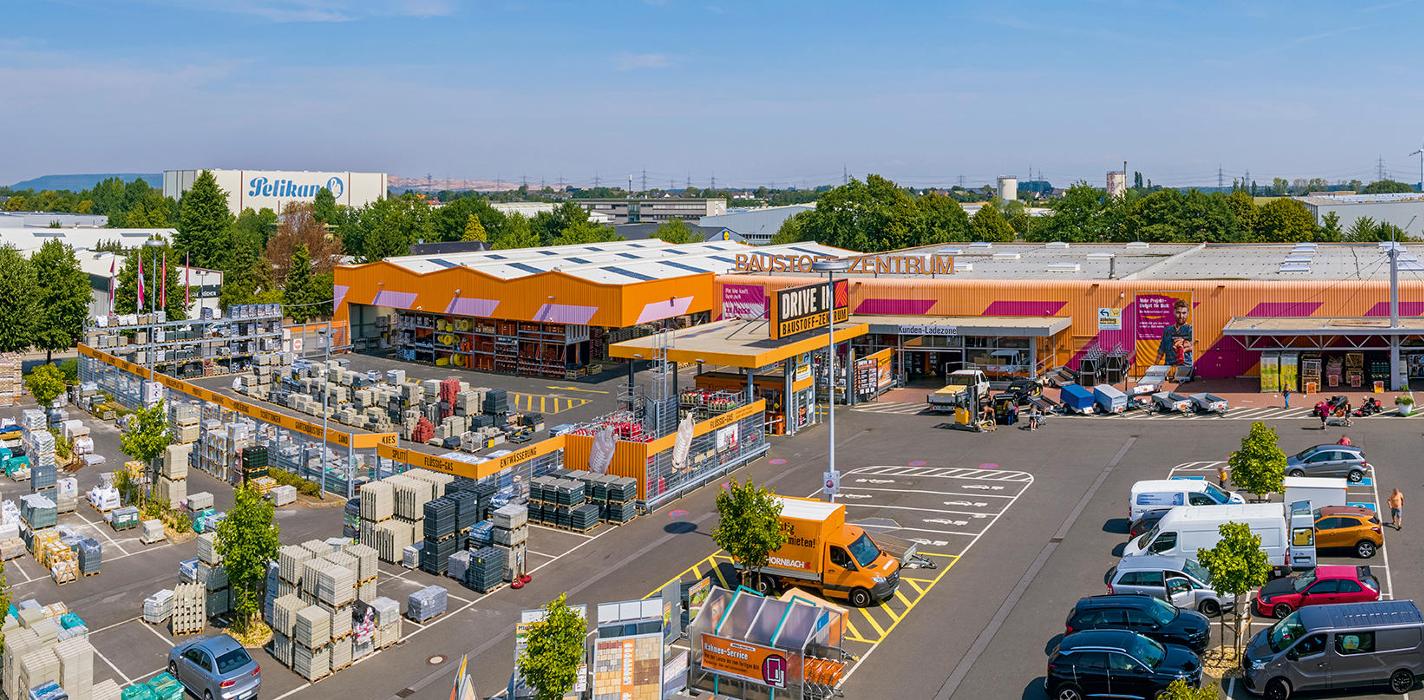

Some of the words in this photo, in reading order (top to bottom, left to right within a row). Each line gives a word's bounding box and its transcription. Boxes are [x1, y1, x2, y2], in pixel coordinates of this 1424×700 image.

[248, 176, 320, 198] Pelikan
[735, 253, 839, 273] BAUSTO
[847, 256, 955, 275] ZENTRUM
[782, 288, 817, 320] DRIVE
[782, 309, 847, 335] BAUSTOFF-ZENRUM
[382, 436, 395, 444] KIES
